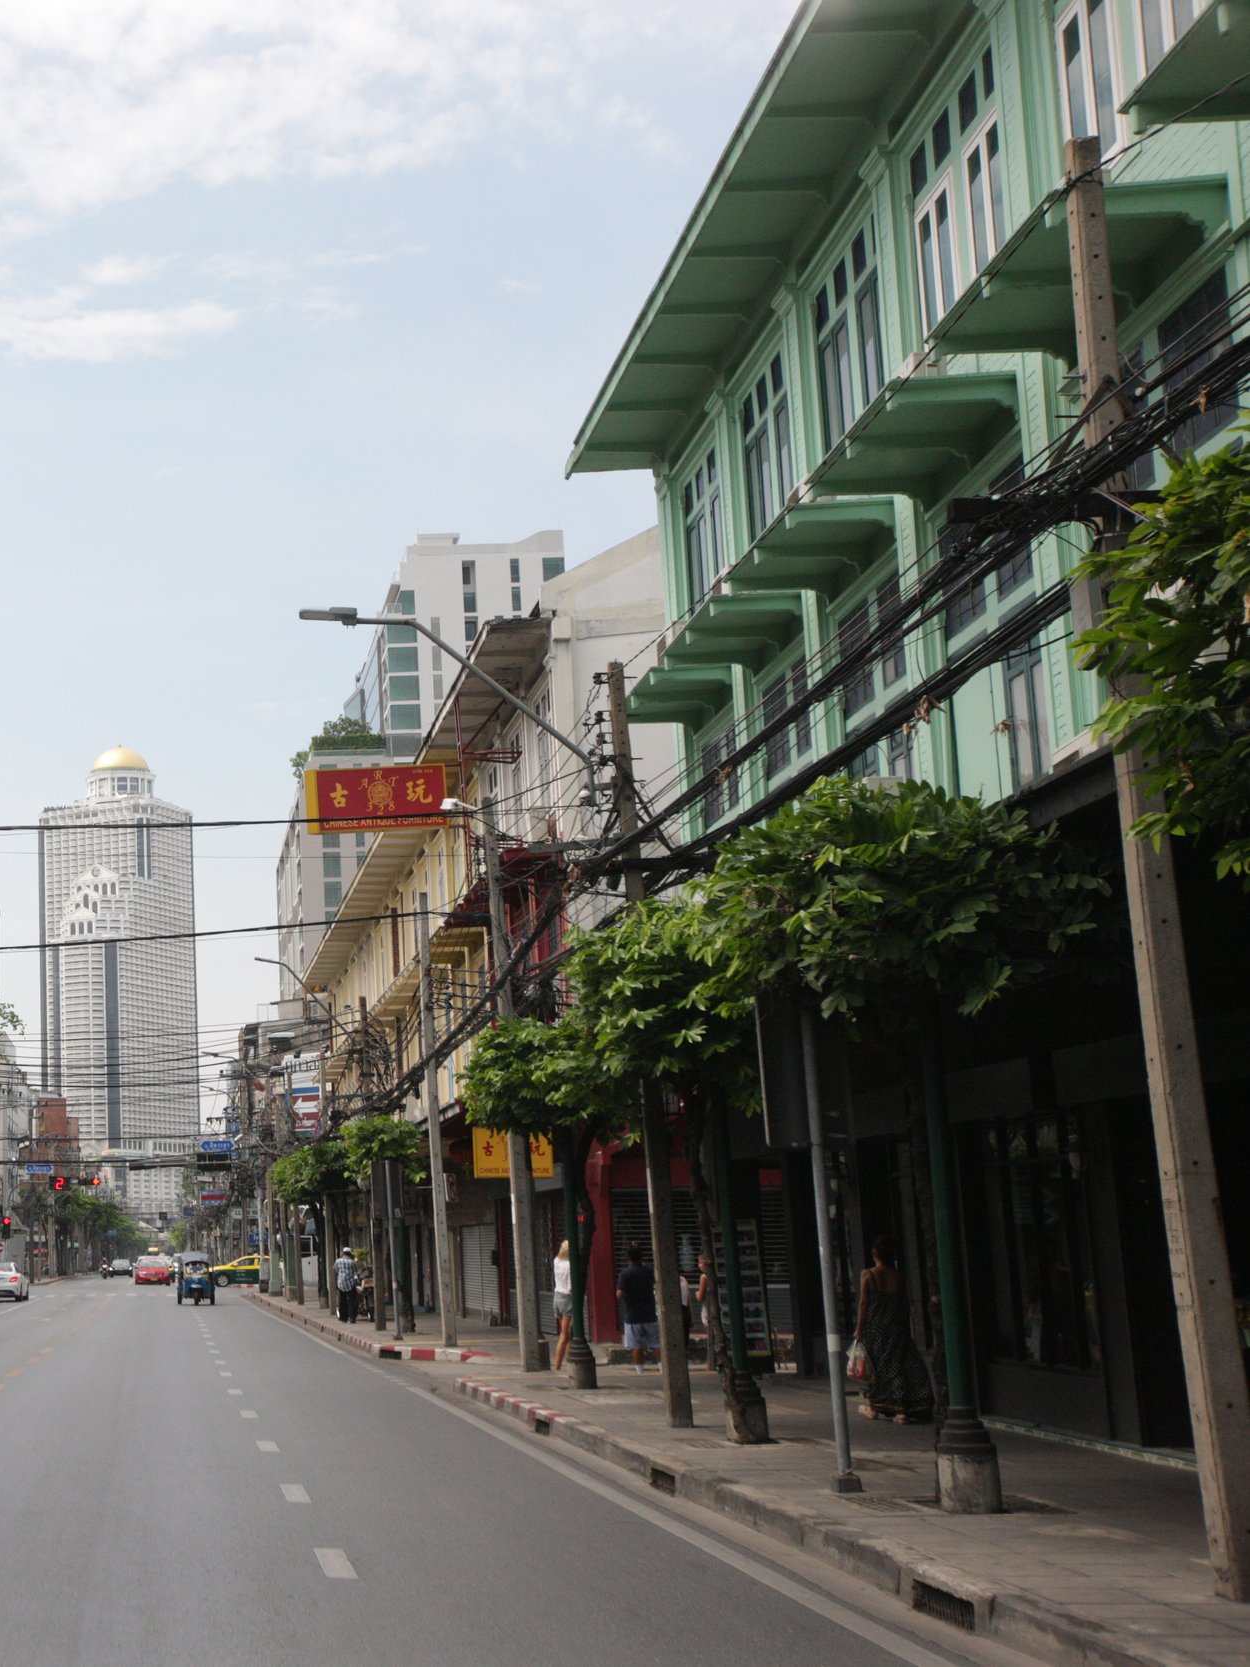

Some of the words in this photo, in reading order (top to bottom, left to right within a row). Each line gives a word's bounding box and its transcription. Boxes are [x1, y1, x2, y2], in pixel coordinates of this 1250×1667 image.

[358, 770, 399, 790] ART
[329, 782, 349, 808] 古
[405, 778, 433, 804] 玩
[366, 801, 395, 815] 328
[324, 819, 358, 828] CHINESE
[360, 817, 396, 827] ANTIQUE
[55, 1177, 64, 1190] 2
